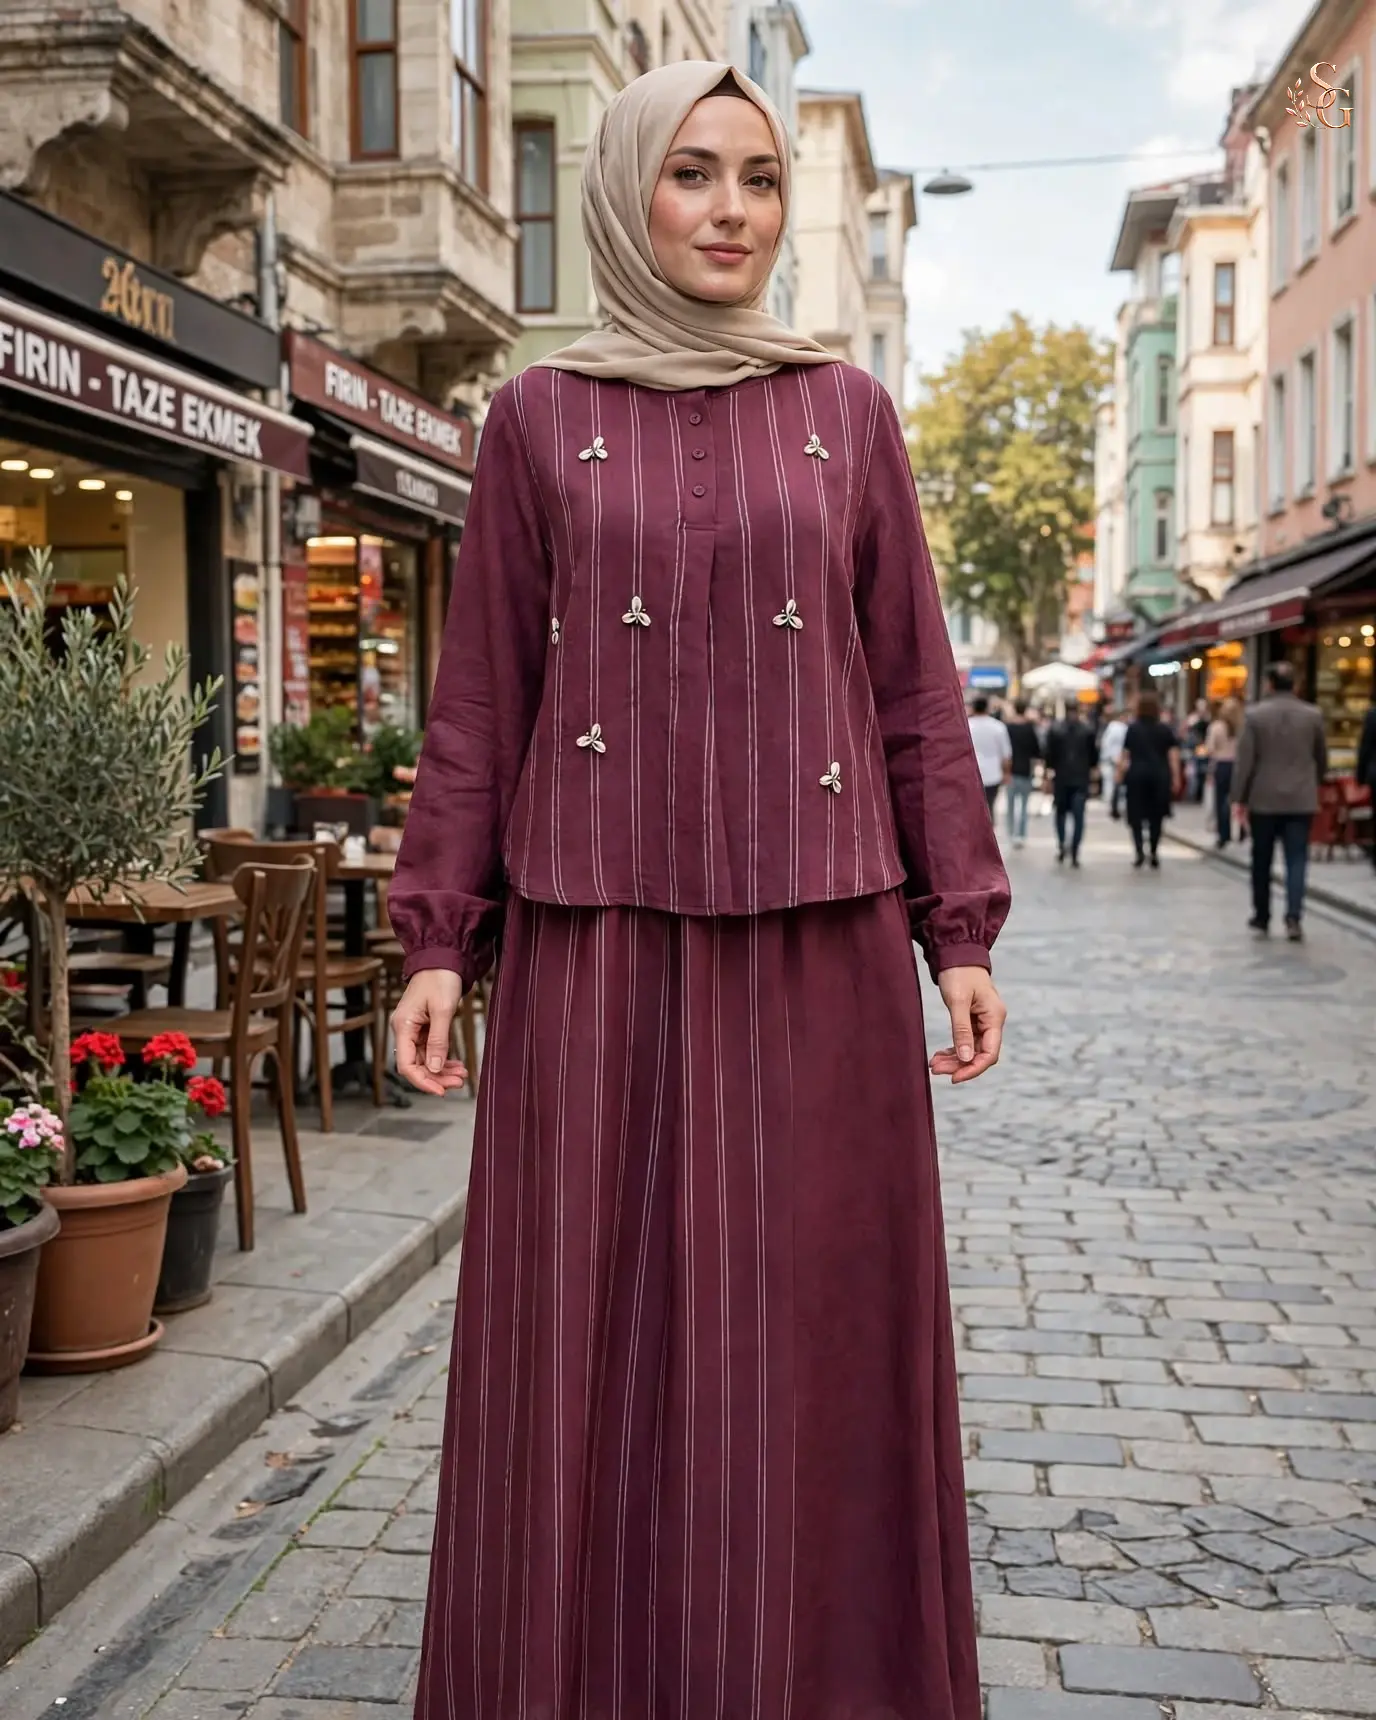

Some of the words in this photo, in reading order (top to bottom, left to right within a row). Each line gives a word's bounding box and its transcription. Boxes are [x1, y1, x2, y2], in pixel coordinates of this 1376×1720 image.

[0, 320, 81, 397] FIRIN
[106, 364, 176, 429] TAZE
[182, 393, 263, 460] EKMEK
